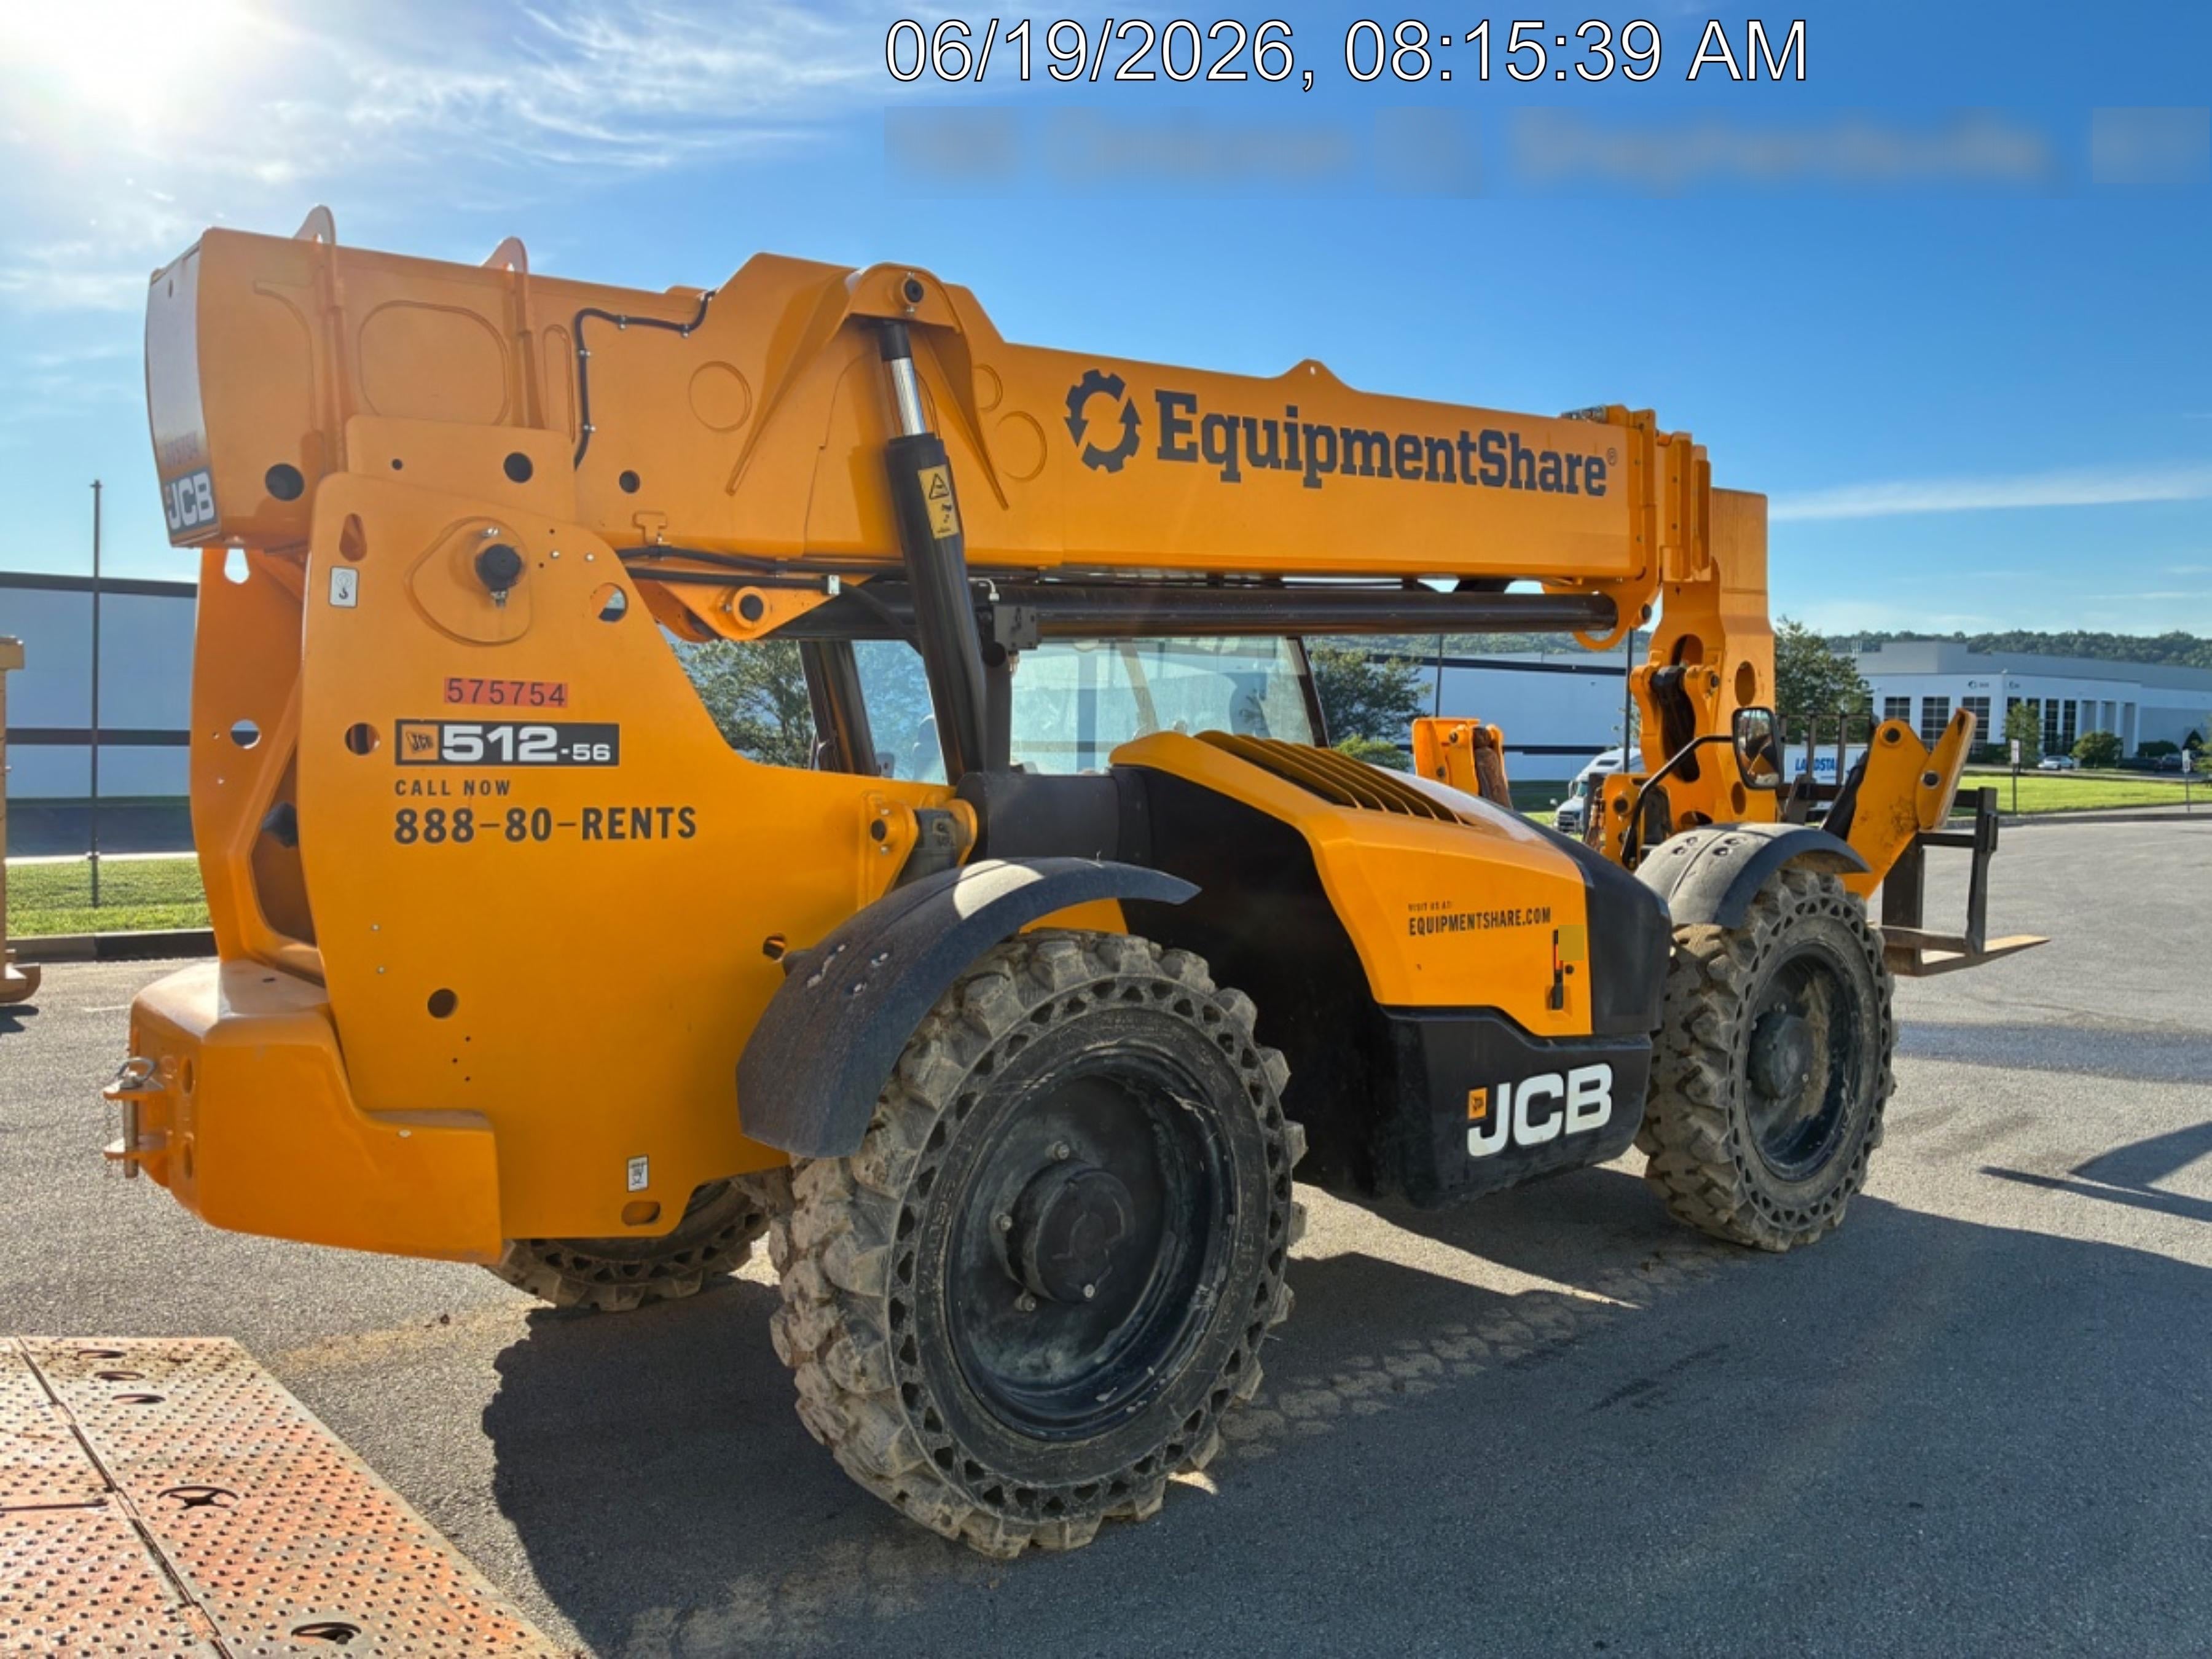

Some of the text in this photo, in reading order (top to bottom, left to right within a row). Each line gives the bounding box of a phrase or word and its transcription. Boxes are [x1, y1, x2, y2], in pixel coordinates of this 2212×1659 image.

[1155, 388, 1606, 496] EquipmentShare
[168, 471, 214, 530] JCB
[447, 678, 565, 706] 575754
[394, 779, 511, 796] CALL NOW
[394, 806, 696, 845] 888-80-RENTS
[1409, 906, 1551, 936] EQUIPMENTSHARE.COM
[1467, 1062, 1612, 1157] JCB
